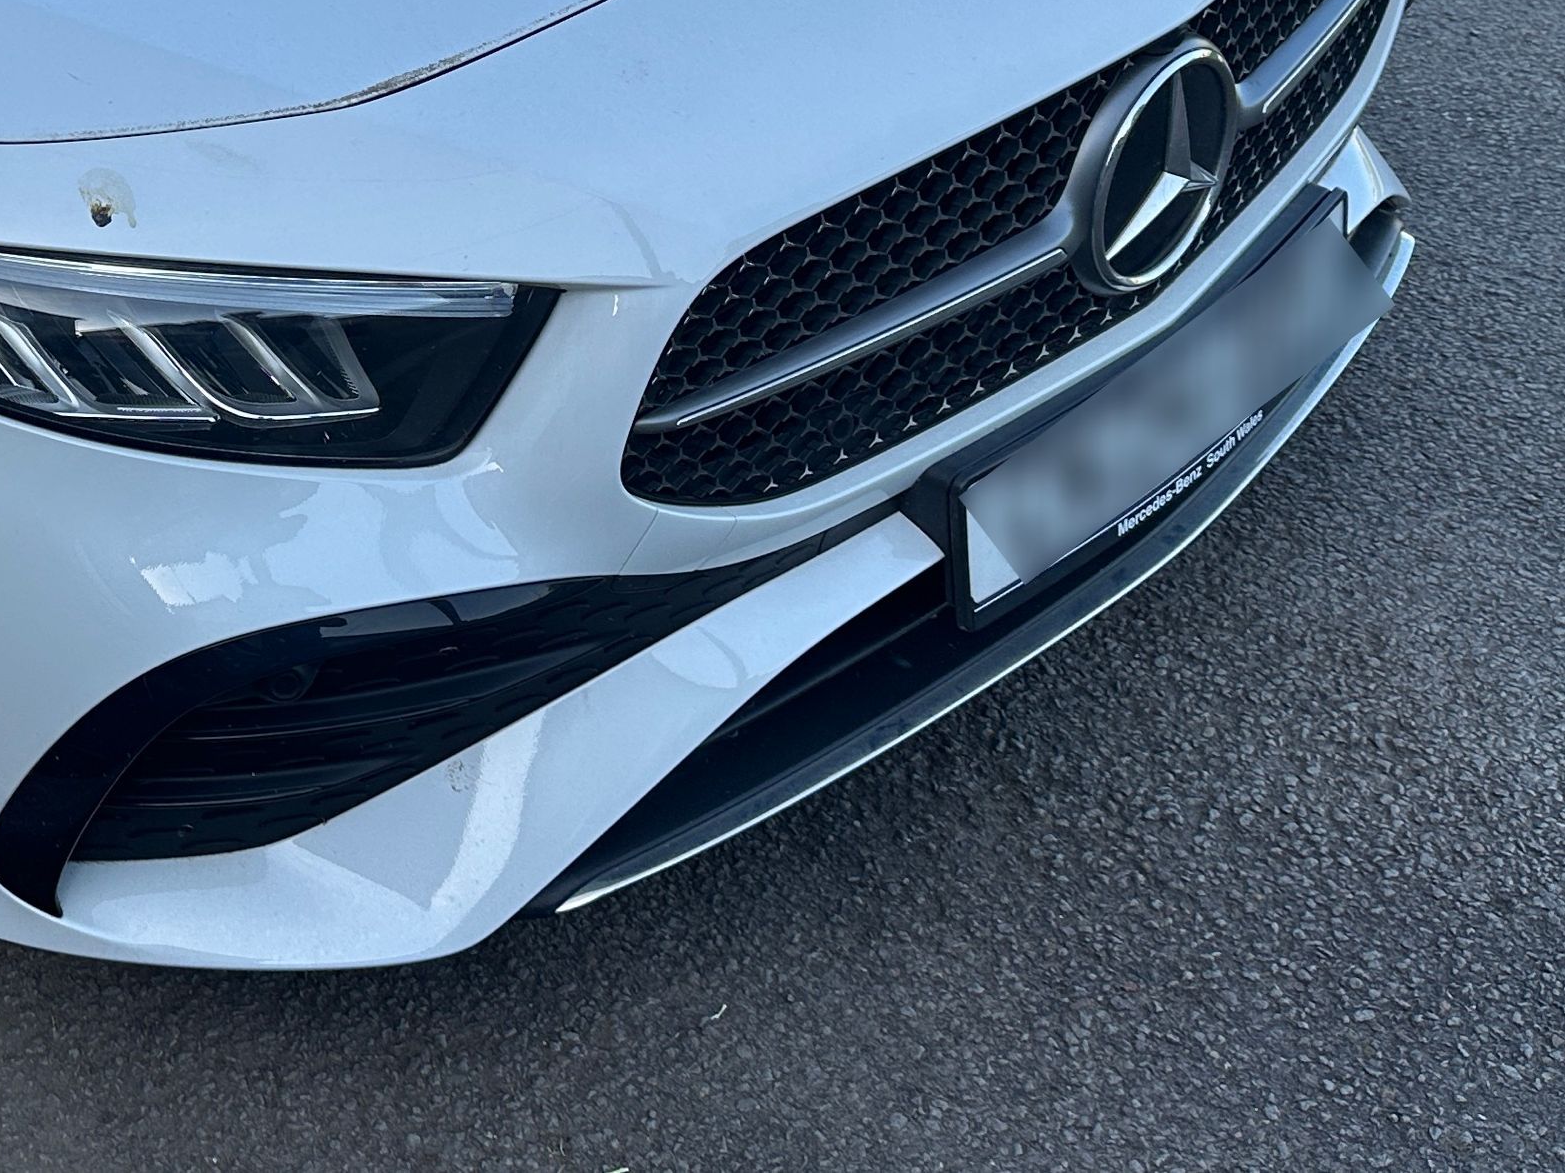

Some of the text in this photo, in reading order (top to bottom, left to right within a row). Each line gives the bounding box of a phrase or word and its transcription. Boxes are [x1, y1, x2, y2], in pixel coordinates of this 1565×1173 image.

[1117, 409, 1264, 537] Mercedes-Benz South Wales
